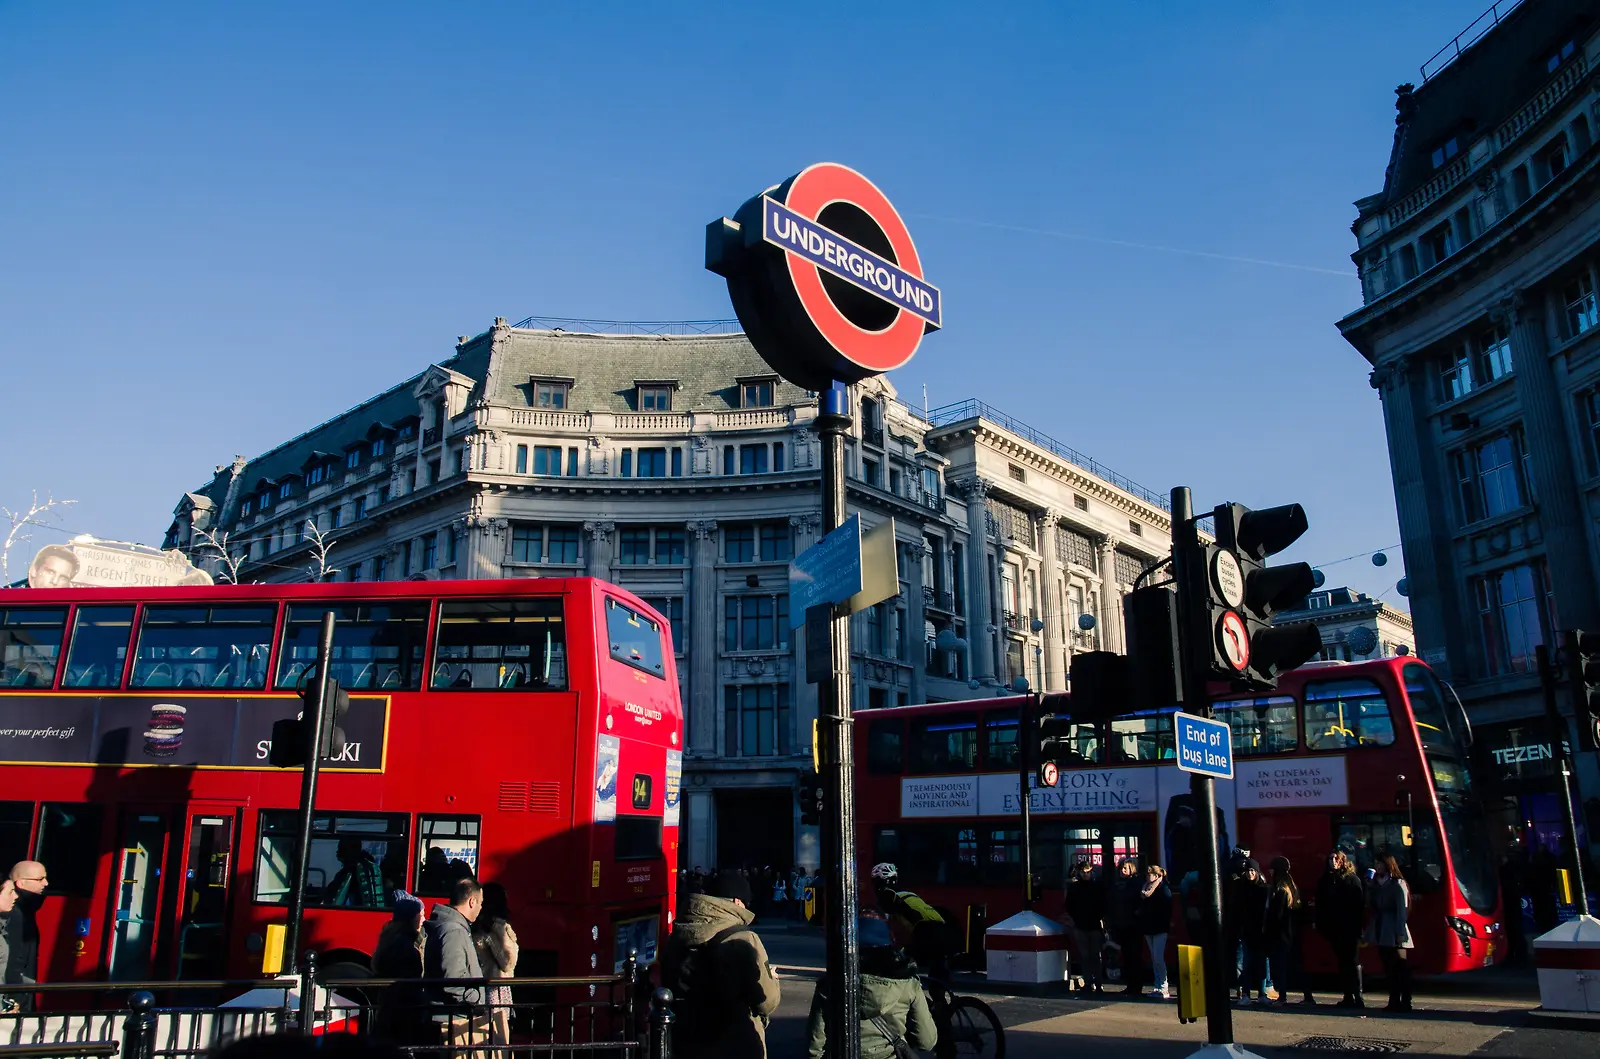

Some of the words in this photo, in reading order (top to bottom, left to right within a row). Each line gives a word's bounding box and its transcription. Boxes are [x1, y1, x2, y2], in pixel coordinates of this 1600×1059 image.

[773, 211, 933, 313] UNDERGROUND
[76, 549, 121, 564] CHRISTMAS
[124, 558, 152, 569] COMES
[156, 562, 167, 572] TO
[86, 565, 128, 582] REGENT
[134, 573, 169, 587] STREET
[624, 701, 644, 716] LONDON
[644, 708, 662, 721] UNITED
[12, 729, 32, 738] your
[31, 726, 60, 739] perfect
[59, 726, 75, 739] gift
[1186, 724, 1207, 744] End
[1209, 731, 1221, 746] of
[1182, 744, 1202, 764] bus
[1204, 748, 1227, 768] lane
[1492, 741, 1571, 764] TEZEN
[1029, 772, 1115, 790] TEORY
[1247, 780, 1270, 788] NEW
[1274, 778, 1308, 787] YEAR'S
[1312, 776, 1333, 786] DAY
[1258, 771, 1270, 779] IN
[1274, 768, 1321, 778] CINEMAS
[634, 778, 647, 802] 94
[913, 791, 947, 801] MOVING
[949, 791, 968, 800] AND
[1258, 790, 1290, 799] BOOK
[1295, 789, 1322, 798] NOW
